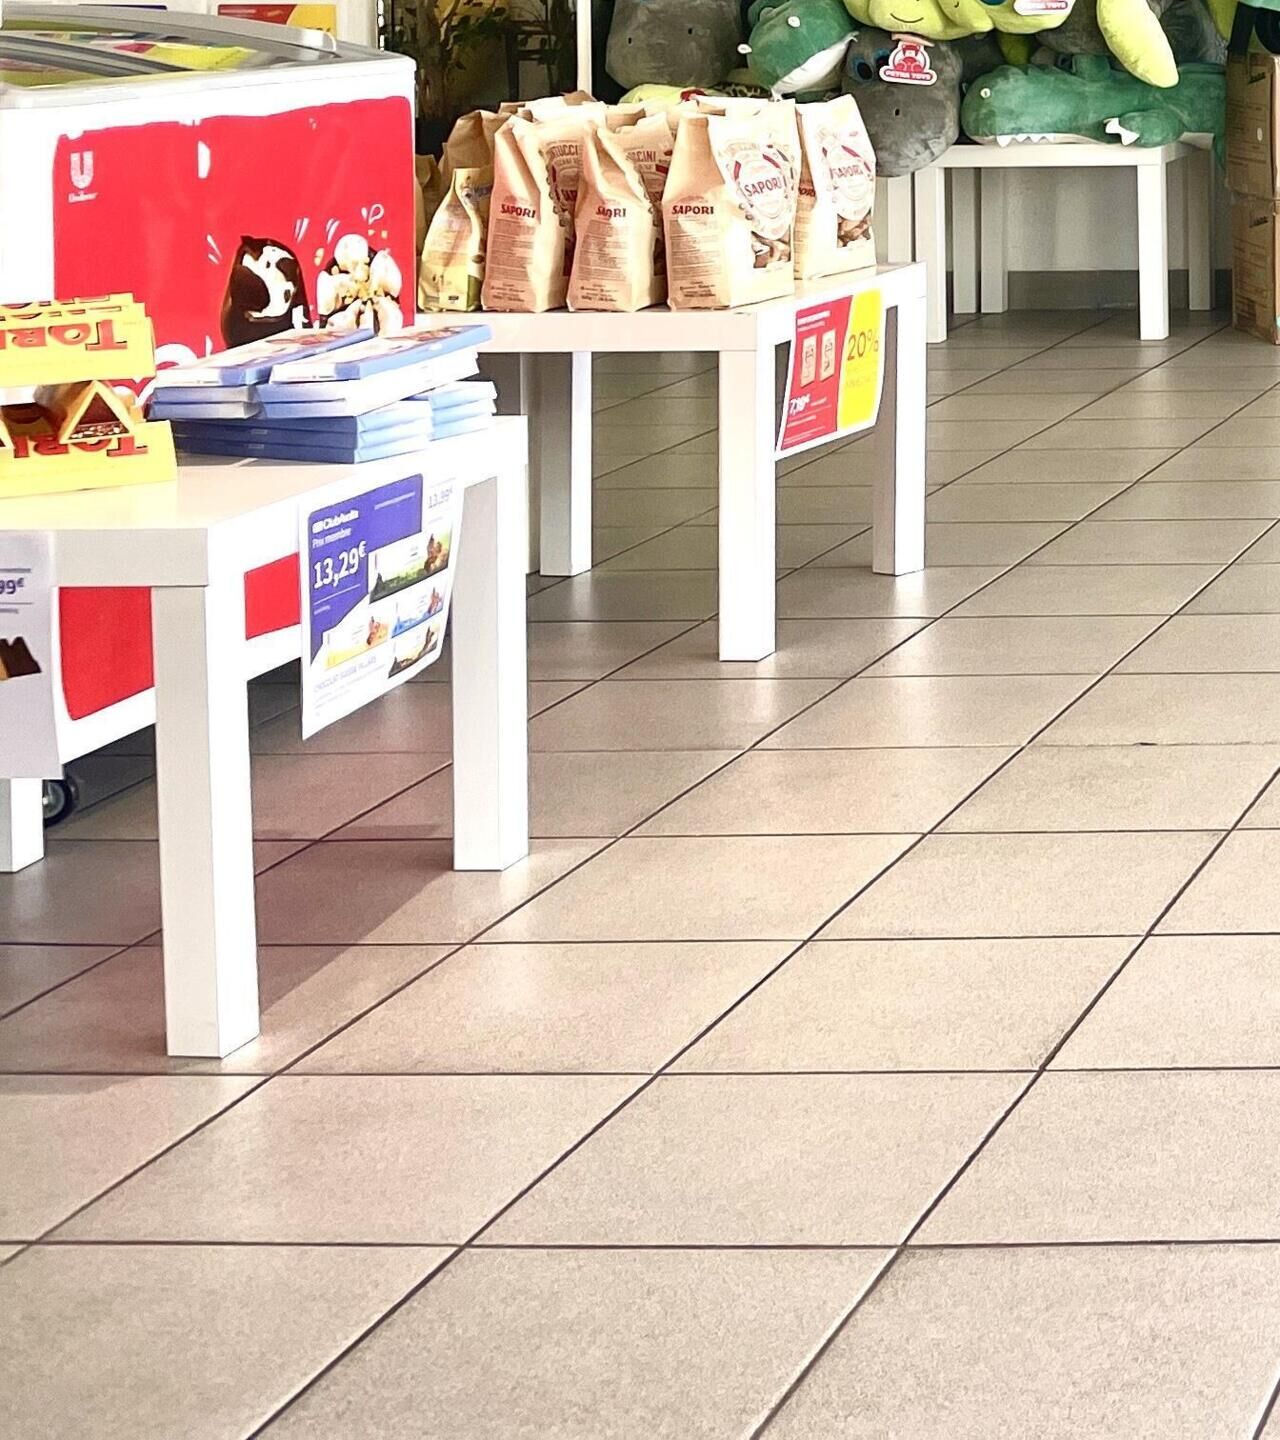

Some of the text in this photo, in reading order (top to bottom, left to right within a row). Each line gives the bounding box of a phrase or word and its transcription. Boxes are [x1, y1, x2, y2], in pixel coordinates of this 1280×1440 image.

[911, 71, 931, 81] TOYS
[744, 175, 784, 197] SAPORI
[500, 203, 537, 219] SAPORI
[671, 204, 715, 216] SAPORI
[847, 328, 880, 362] 20%
[314, 540, 368, 590] 13,29€
